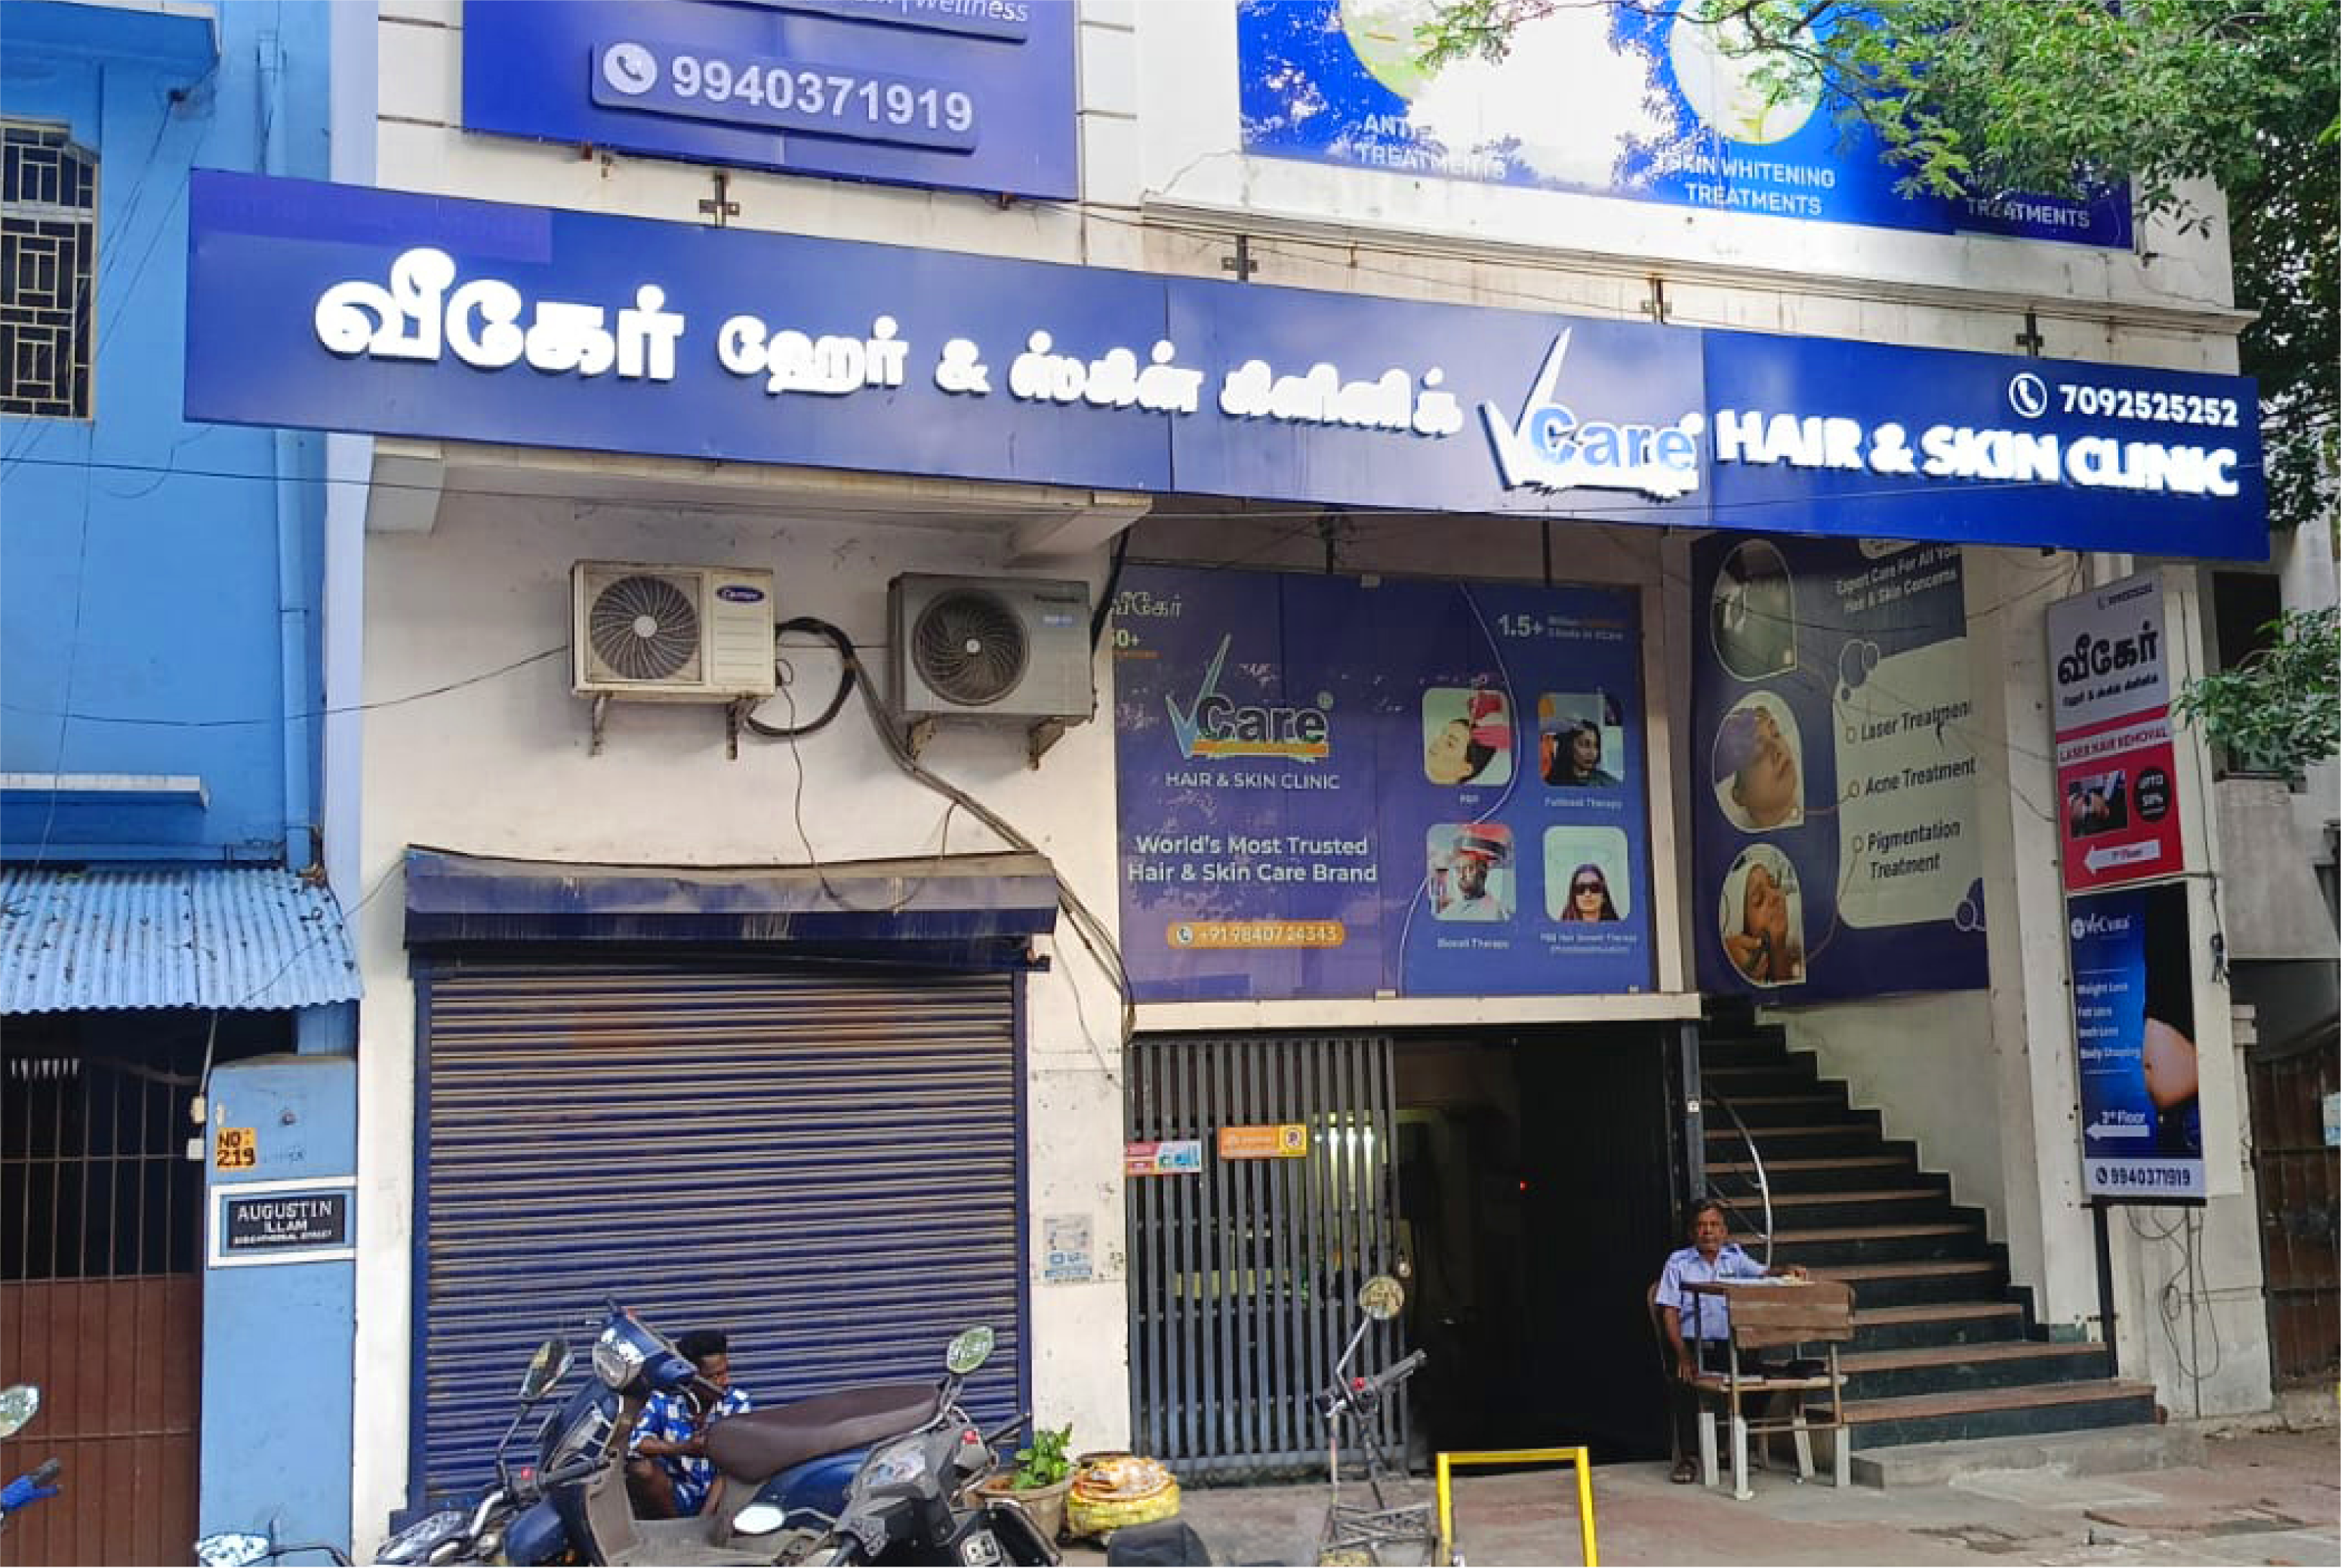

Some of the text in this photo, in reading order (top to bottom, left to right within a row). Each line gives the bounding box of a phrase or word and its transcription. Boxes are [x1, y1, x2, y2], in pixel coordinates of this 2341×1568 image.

[670, 54, 973, 133] 9940371919
[1684, 181, 1822, 216] TREATMENTS
[313, 246, 685, 384] வீகேர்
[935, 337, 993, 394] &
[2059, 385, 2239, 427] 7092525252
[1714, 408, 2240, 497] HAIR & SKIN CLINIC
[1498, 614, 1545, 638] 1.5+
[2057, 619, 2159, 686] வீகேர்
[1861, 717, 1898, 743] Laser
[1165, 772, 1341, 790] HAIR & SKIN CLINIC
[1865, 757, 1977, 796] Acne Treatment
[1135, 834, 1369, 855] World's Most Trusted
[1868, 820, 1961, 853] Pigmentation
[1127, 863, 1378, 883] Hair & Skin Care Brand
[1870, 852, 1941, 881] Treatment
[237, 1200, 333, 1222] AUGUSTIN
